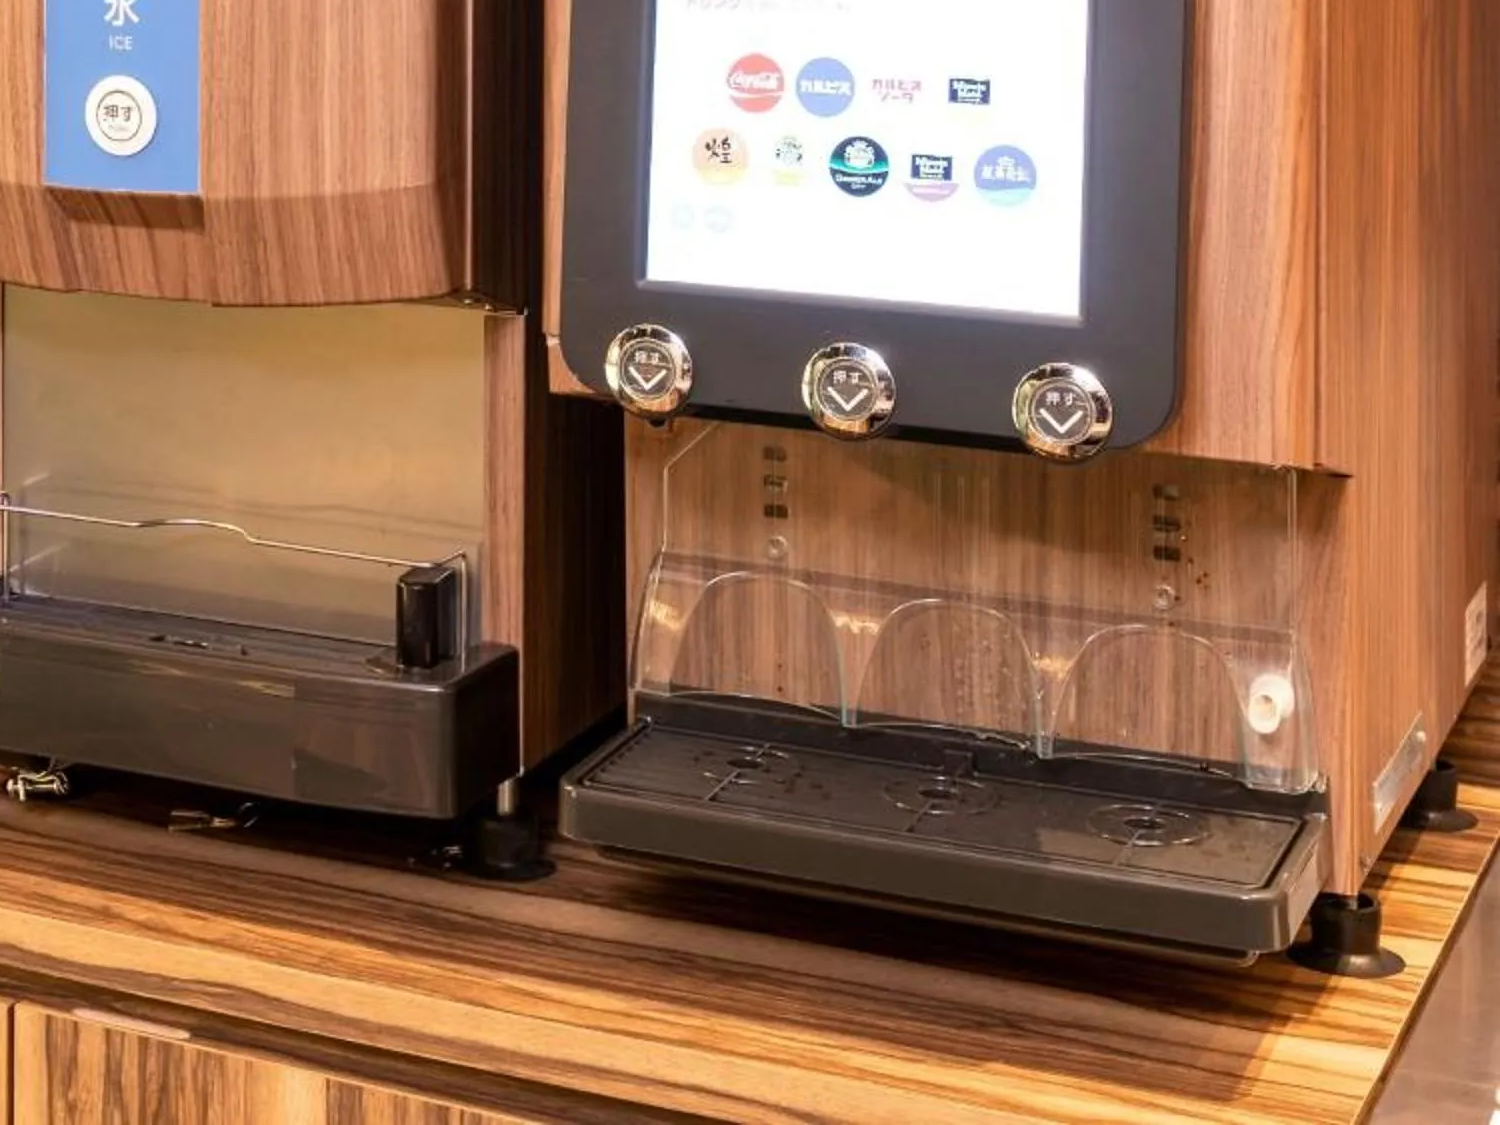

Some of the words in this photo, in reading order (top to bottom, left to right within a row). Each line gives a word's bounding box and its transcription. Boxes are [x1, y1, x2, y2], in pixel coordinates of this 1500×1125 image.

[109, 35, 133, 51] ICE
[102, 104, 135, 122] 押す
[833, 370, 862, 385] 押す
[1045, 391, 1077, 406] 押す
